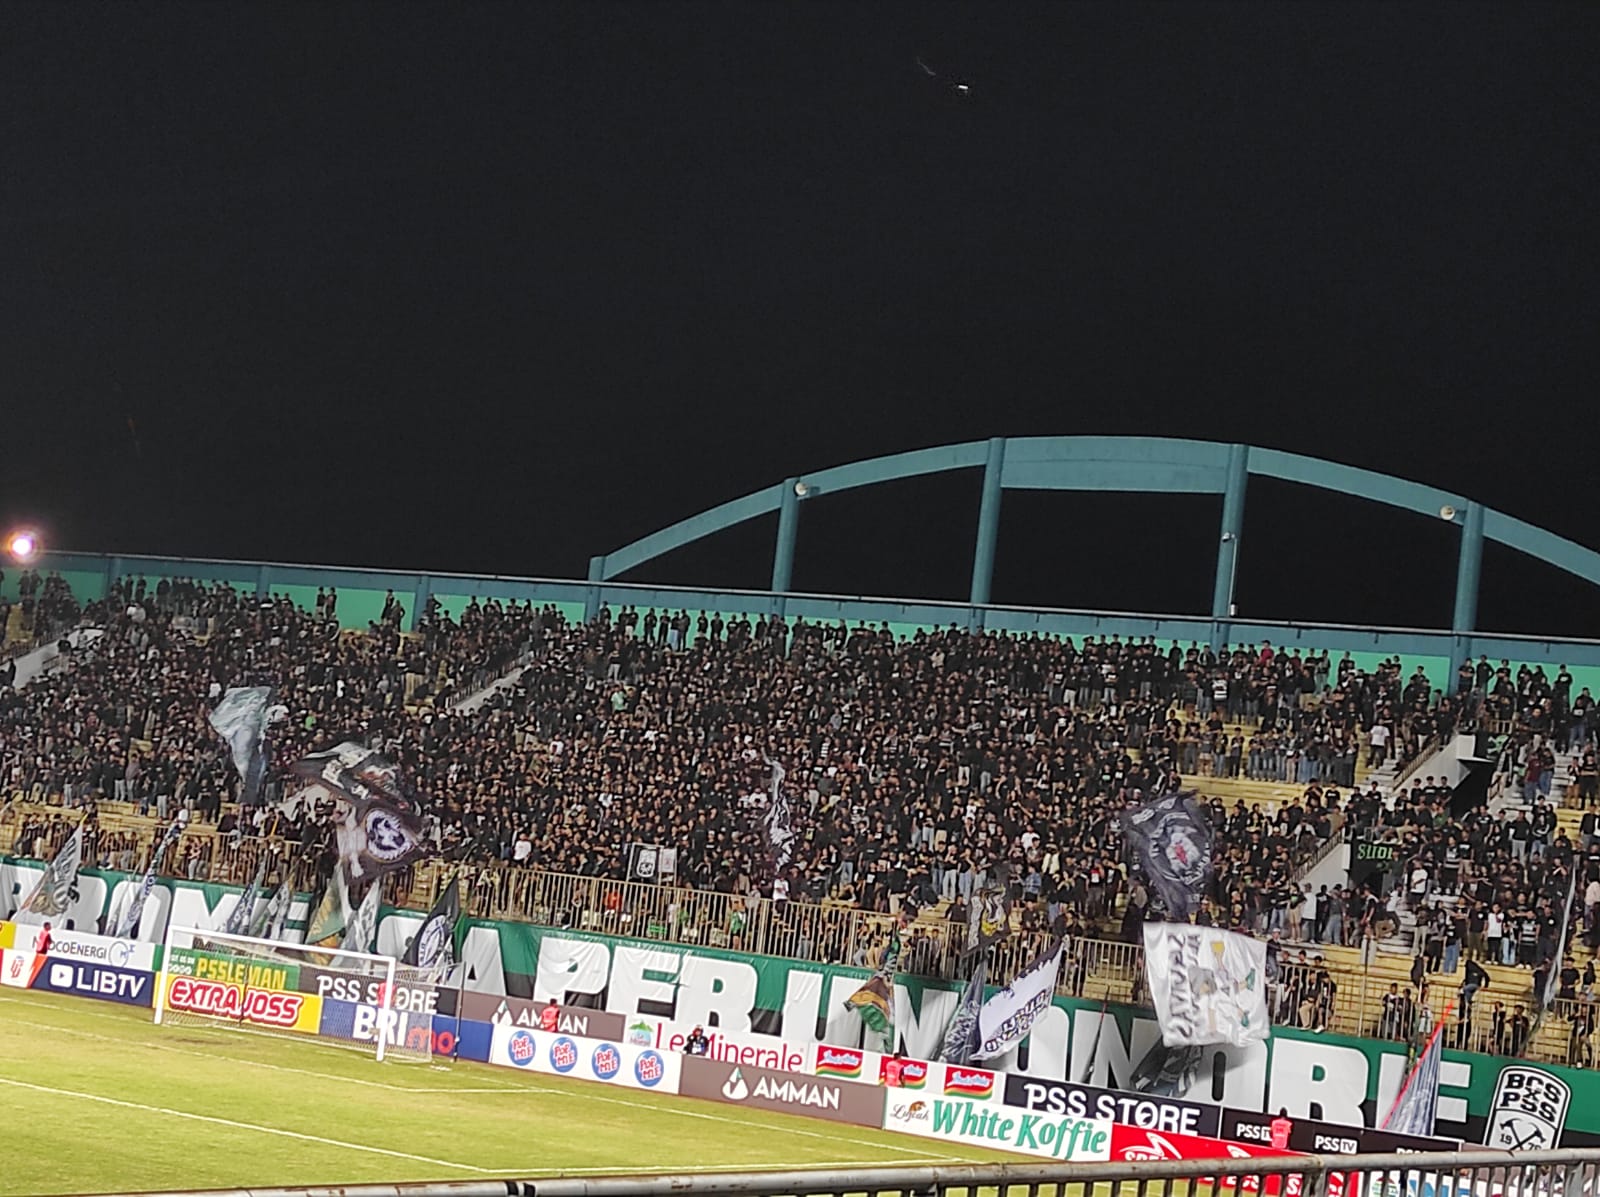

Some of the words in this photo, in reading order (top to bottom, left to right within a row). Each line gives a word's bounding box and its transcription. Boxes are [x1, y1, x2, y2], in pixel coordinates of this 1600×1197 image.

[76, 967, 146, 998] LIBTV
[316, 975, 361, 1003] PSS
[366, 983, 440, 1014] SORE
[170, 978, 242, 1016] EXTRA
[243, 988, 302, 1024] JOSS
[516, 1008, 588, 1035] AMAN
[753, 1076, 840, 1110] AMMAN
[1024, 1083, 1087, 1118] PSS
[1095, 1094, 1201, 1137] STORE
[1499, 1092, 1557, 1123] PSS
[933, 1100, 1014, 1141] White
[1014, 1114, 1108, 1160] Koffie
